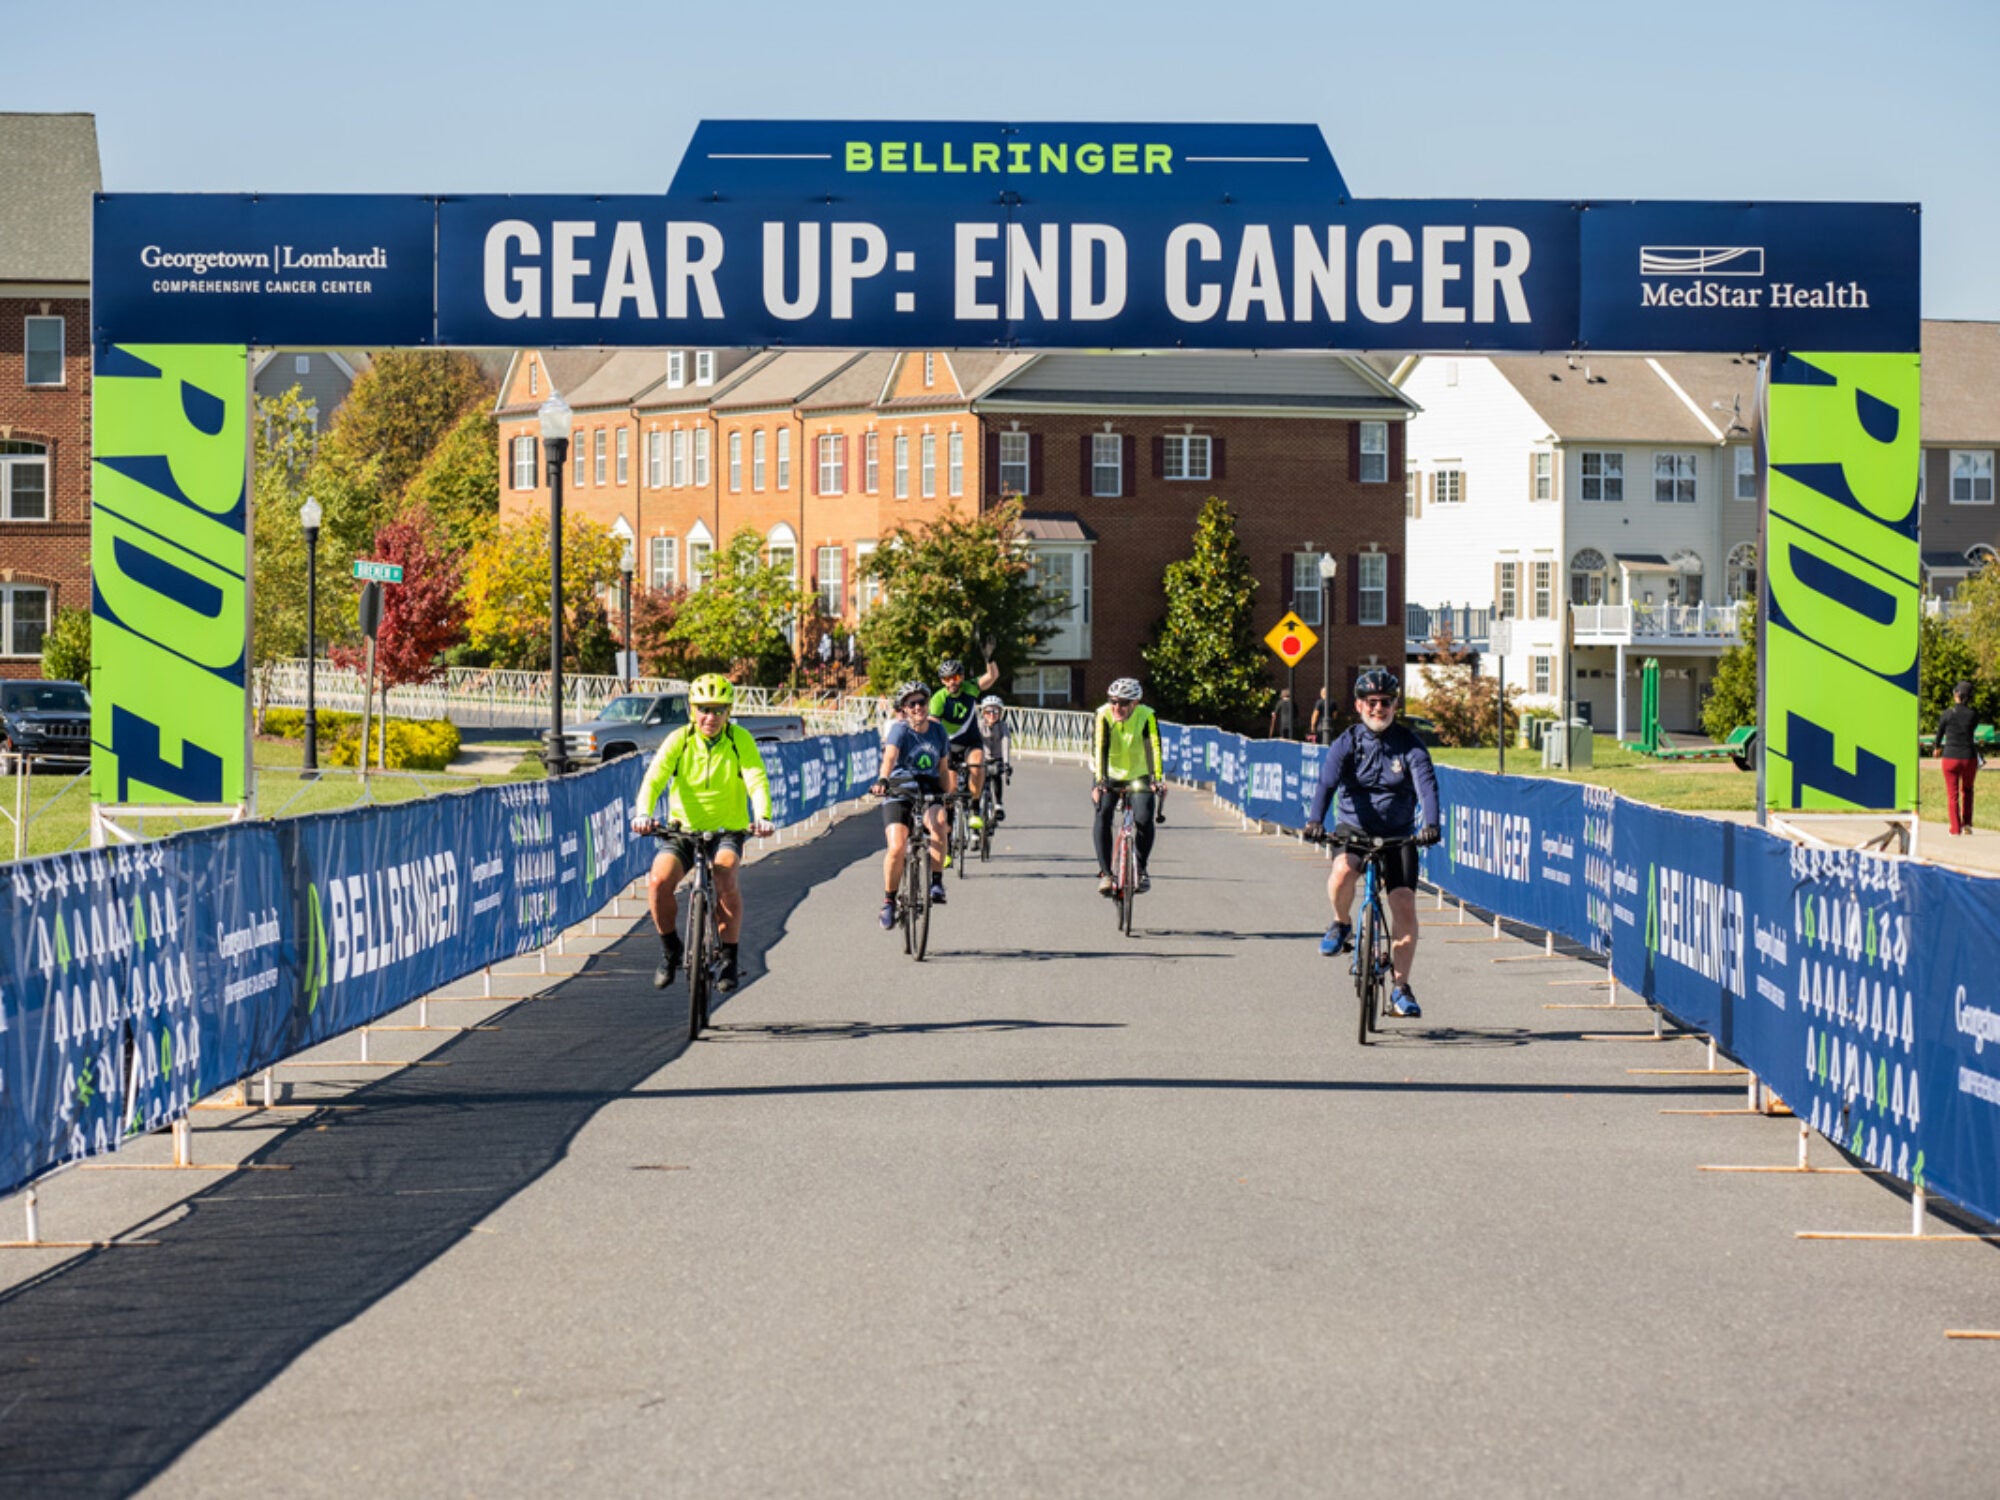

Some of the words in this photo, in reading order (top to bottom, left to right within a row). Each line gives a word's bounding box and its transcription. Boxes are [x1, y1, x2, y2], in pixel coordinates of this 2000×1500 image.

[844, 141, 1173, 174] BELLRINGER
[140, 245, 270, 275] Georgetown
[282, 245, 388, 270] Lombardi
[484, 219, 725, 320] GEAR
[763, 221, 915, 320] UP:
[954, 222, 1127, 322] END
[1165, 223, 1532, 324] CANCER
[152, 280, 261, 295] COMPREHENSIVE
[265, 280, 317, 295] CANCER
[321, 280, 372, 295] CENTER
[1640, 281, 1763, 308] MedStar
[1770, 281, 1870, 309] Health
[329, 850, 459, 984] BELLRINGER
[1659, 866, 1746, 1000] BELLRINGER
